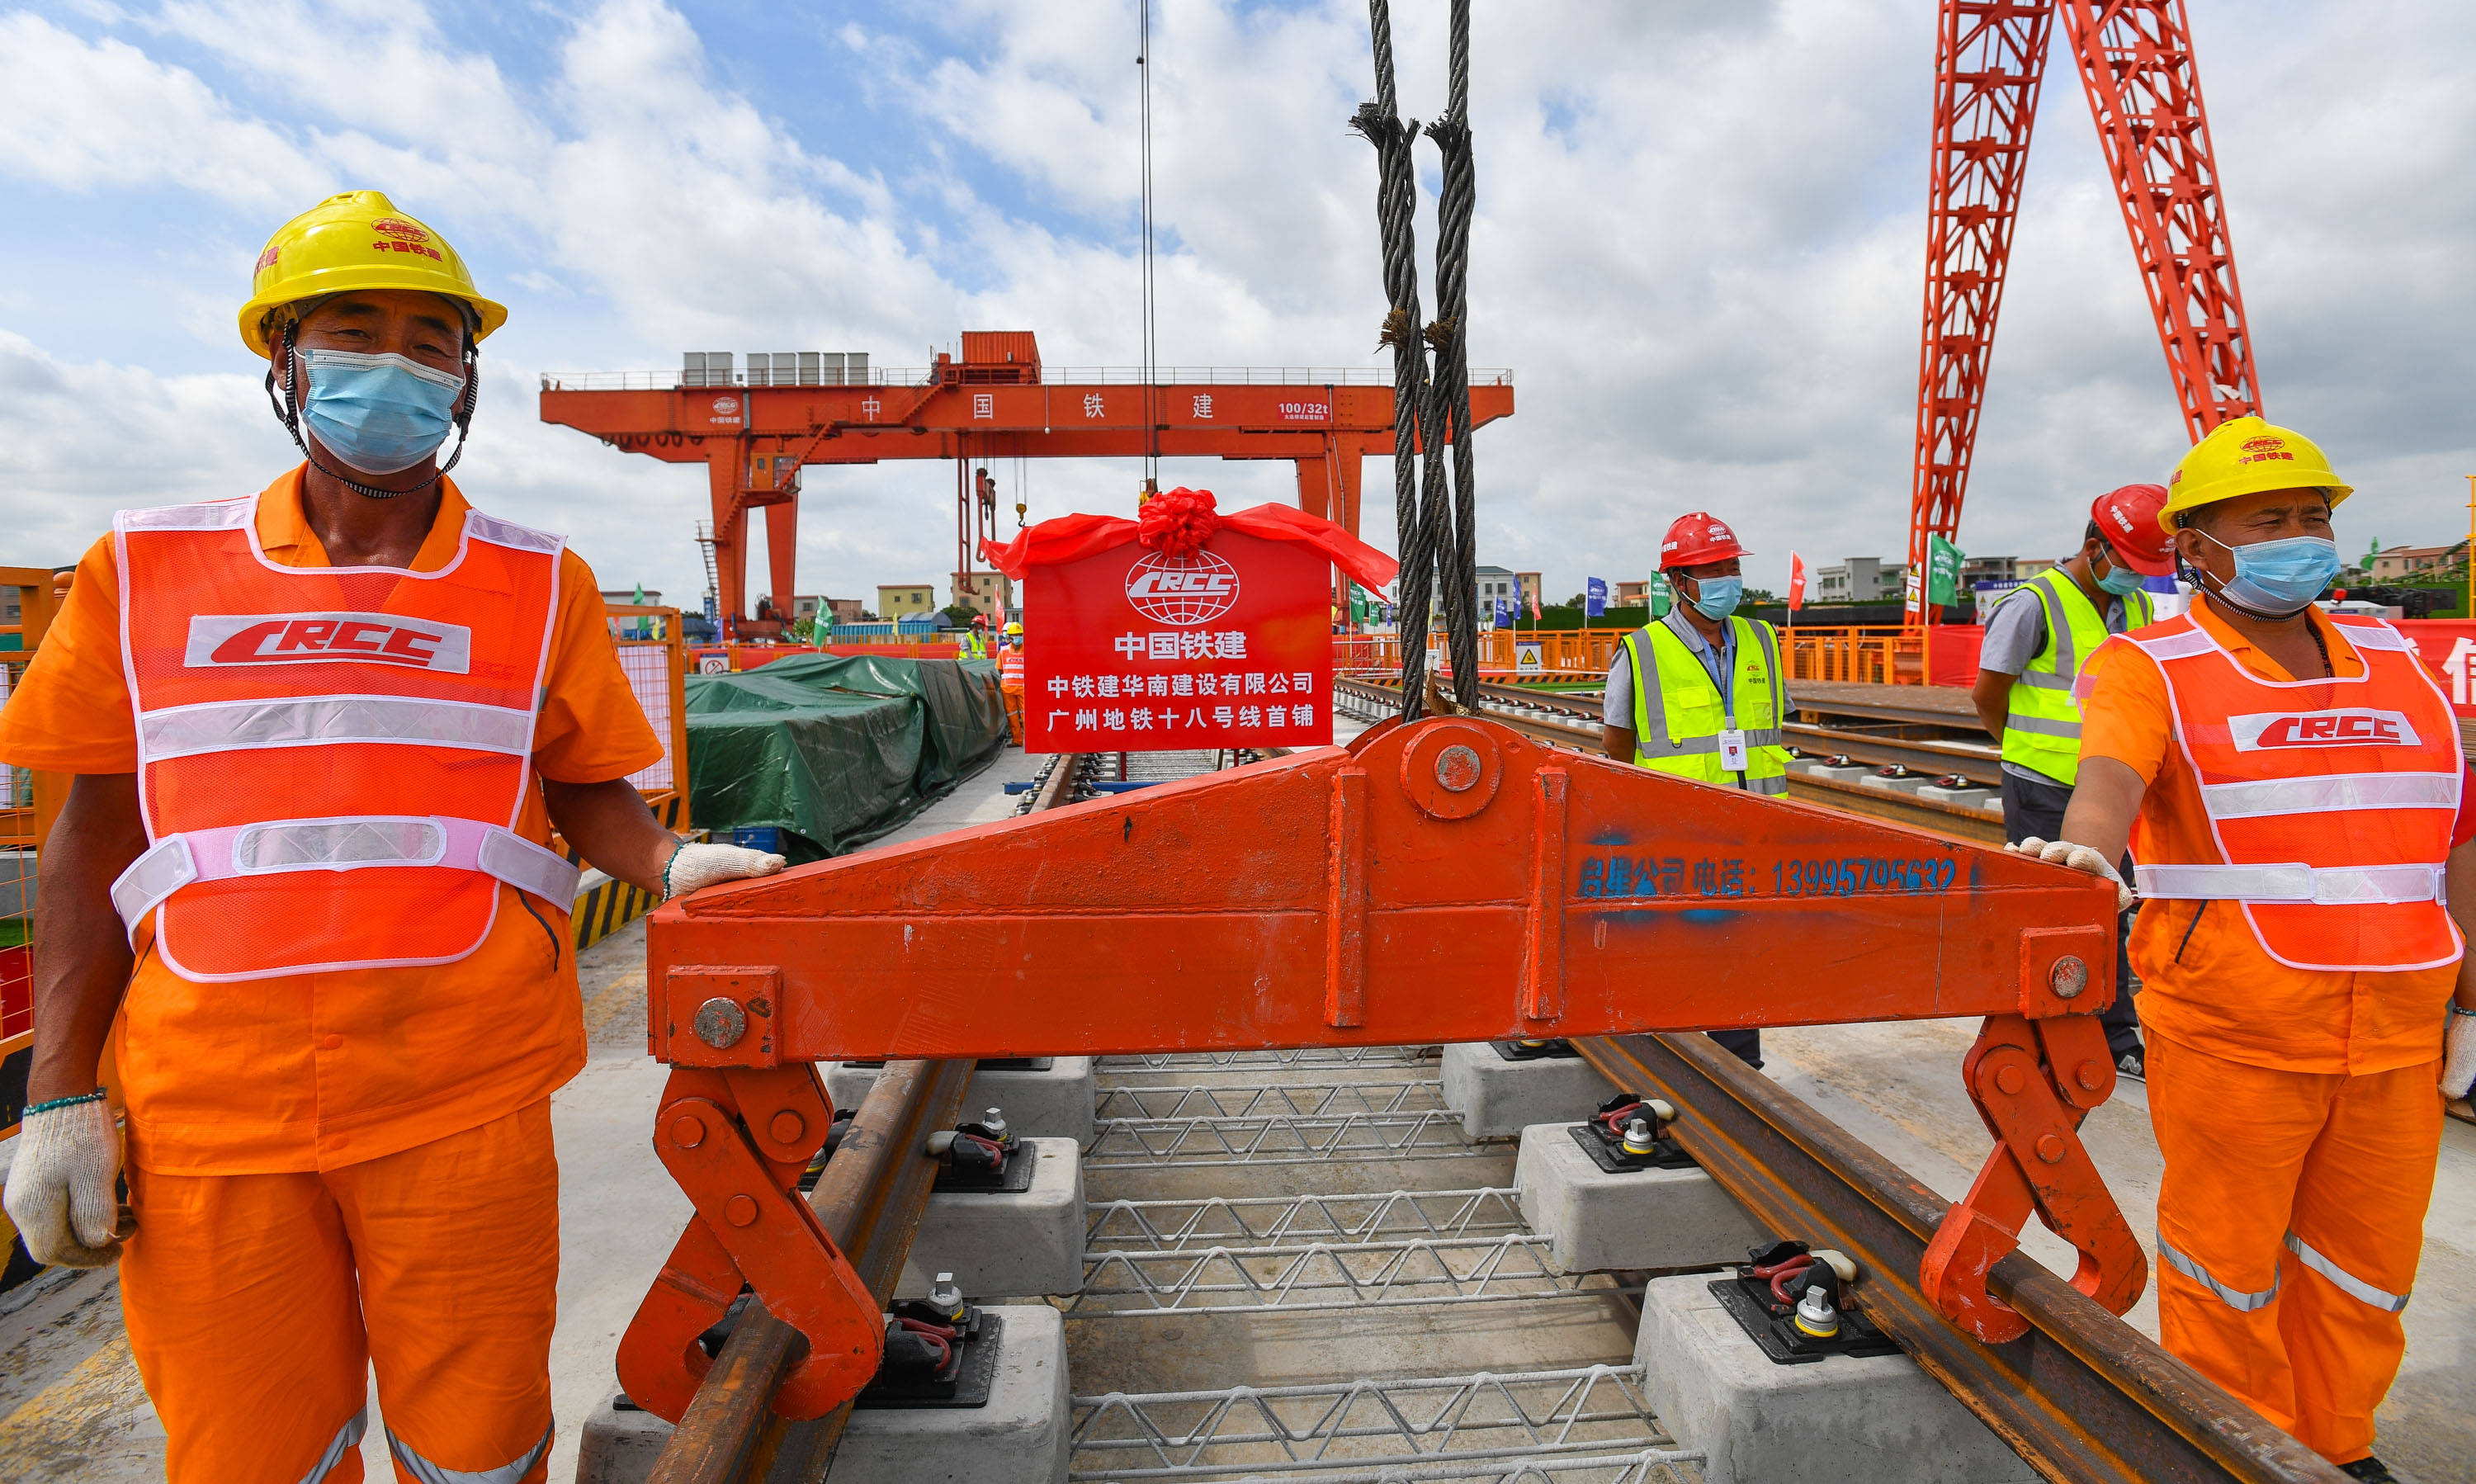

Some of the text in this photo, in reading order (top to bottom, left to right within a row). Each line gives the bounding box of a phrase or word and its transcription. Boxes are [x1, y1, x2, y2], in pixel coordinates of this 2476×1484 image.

[372, 240, 443, 262] 中国铁建
[1278, 402, 1329, 414] 100/32t
[2238, 451, 2294, 465] 中国铁建
[1129, 570, 1235, 598] CRCC
[210, 619, 442, 666] CRCC
[1114, 630, 1248, 661] 中国铁建
[1047, 671, 1314, 700] 中铁建华南建设有限公司
[1047, 703, 1315, 732] 广州地铁十八号线首铺
[2256, 716, 2401, 749] CRCC
[1772, 858, 1956, 898] 13995795632
